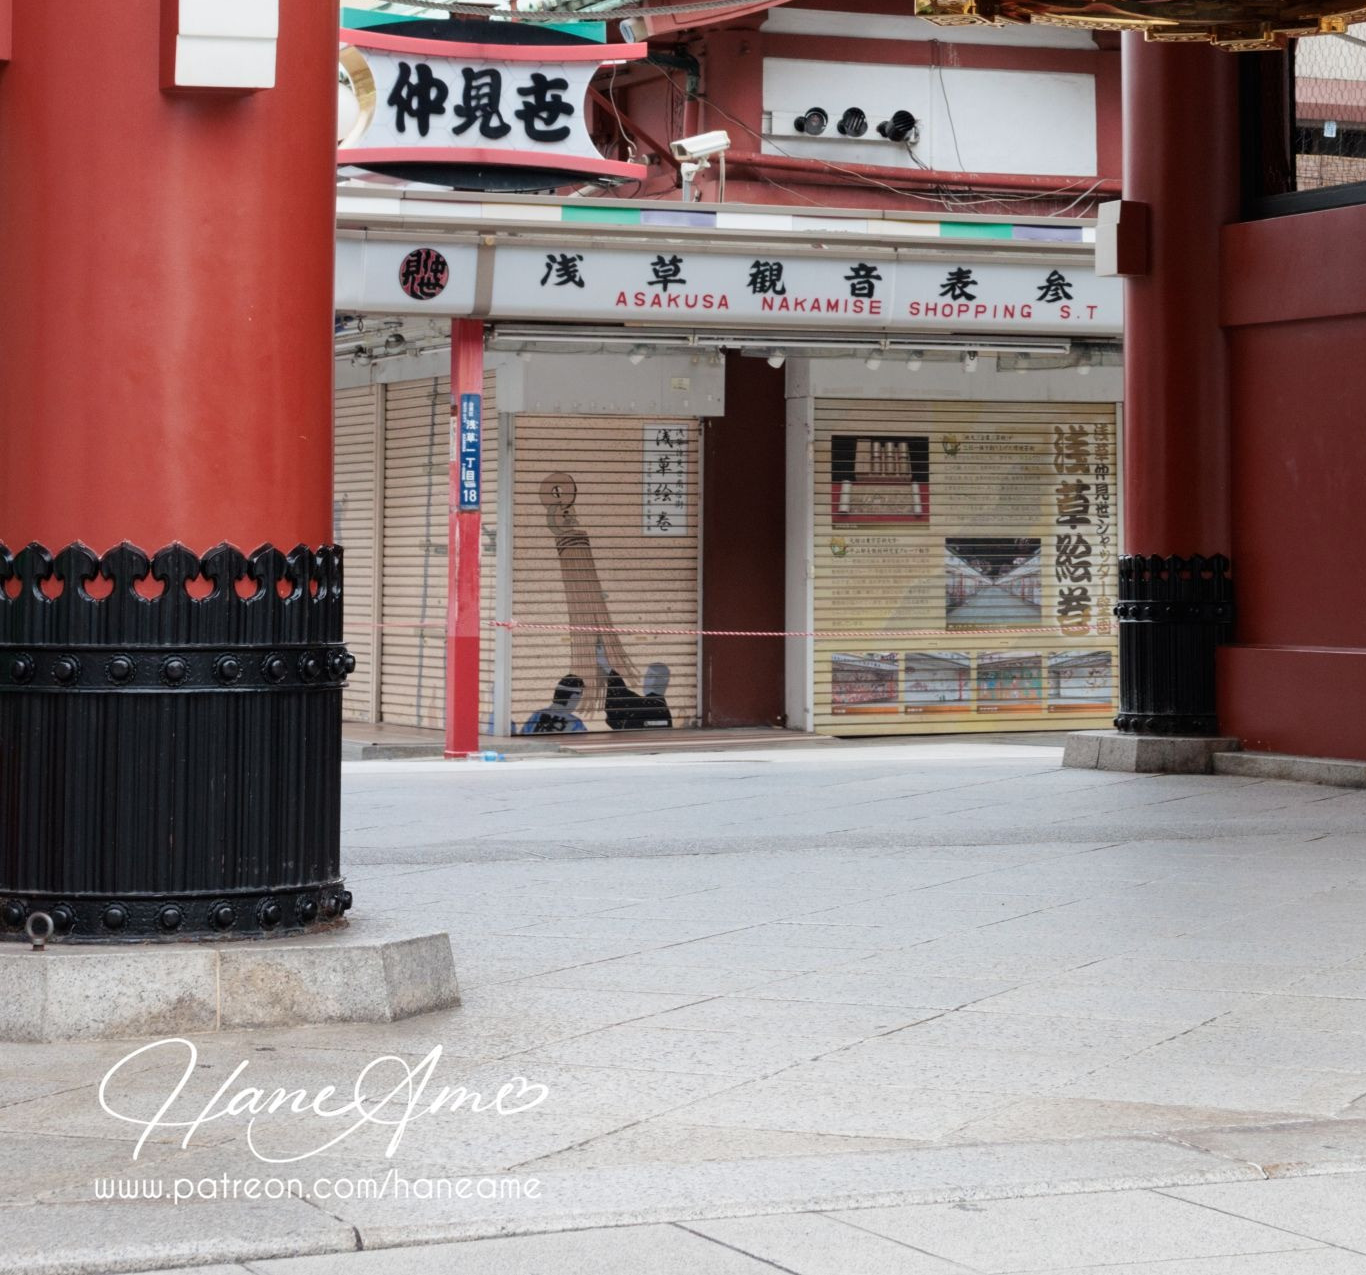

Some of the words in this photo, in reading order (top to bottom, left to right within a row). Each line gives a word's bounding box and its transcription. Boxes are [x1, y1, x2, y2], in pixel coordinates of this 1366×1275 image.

[387, 61, 575, 143] 仲見世
[540, 253, 1074, 304] 浅草観音表参
[615, 291, 730, 310] ASAKUSA
[761, 296, 883, 315] NAKAMISE
[908, 301, 1033, 320] SHOPPING
[466, 419, 478, 481] 浅草一丁目
[655, 428, 673, 532] 浅草絵巻
[463, 489, 477, 502] 18
[1054, 424, 1093, 637] 浅草絵巻
[1093, 423, 1111, 635] 浅草仲見世シャッター壁画
